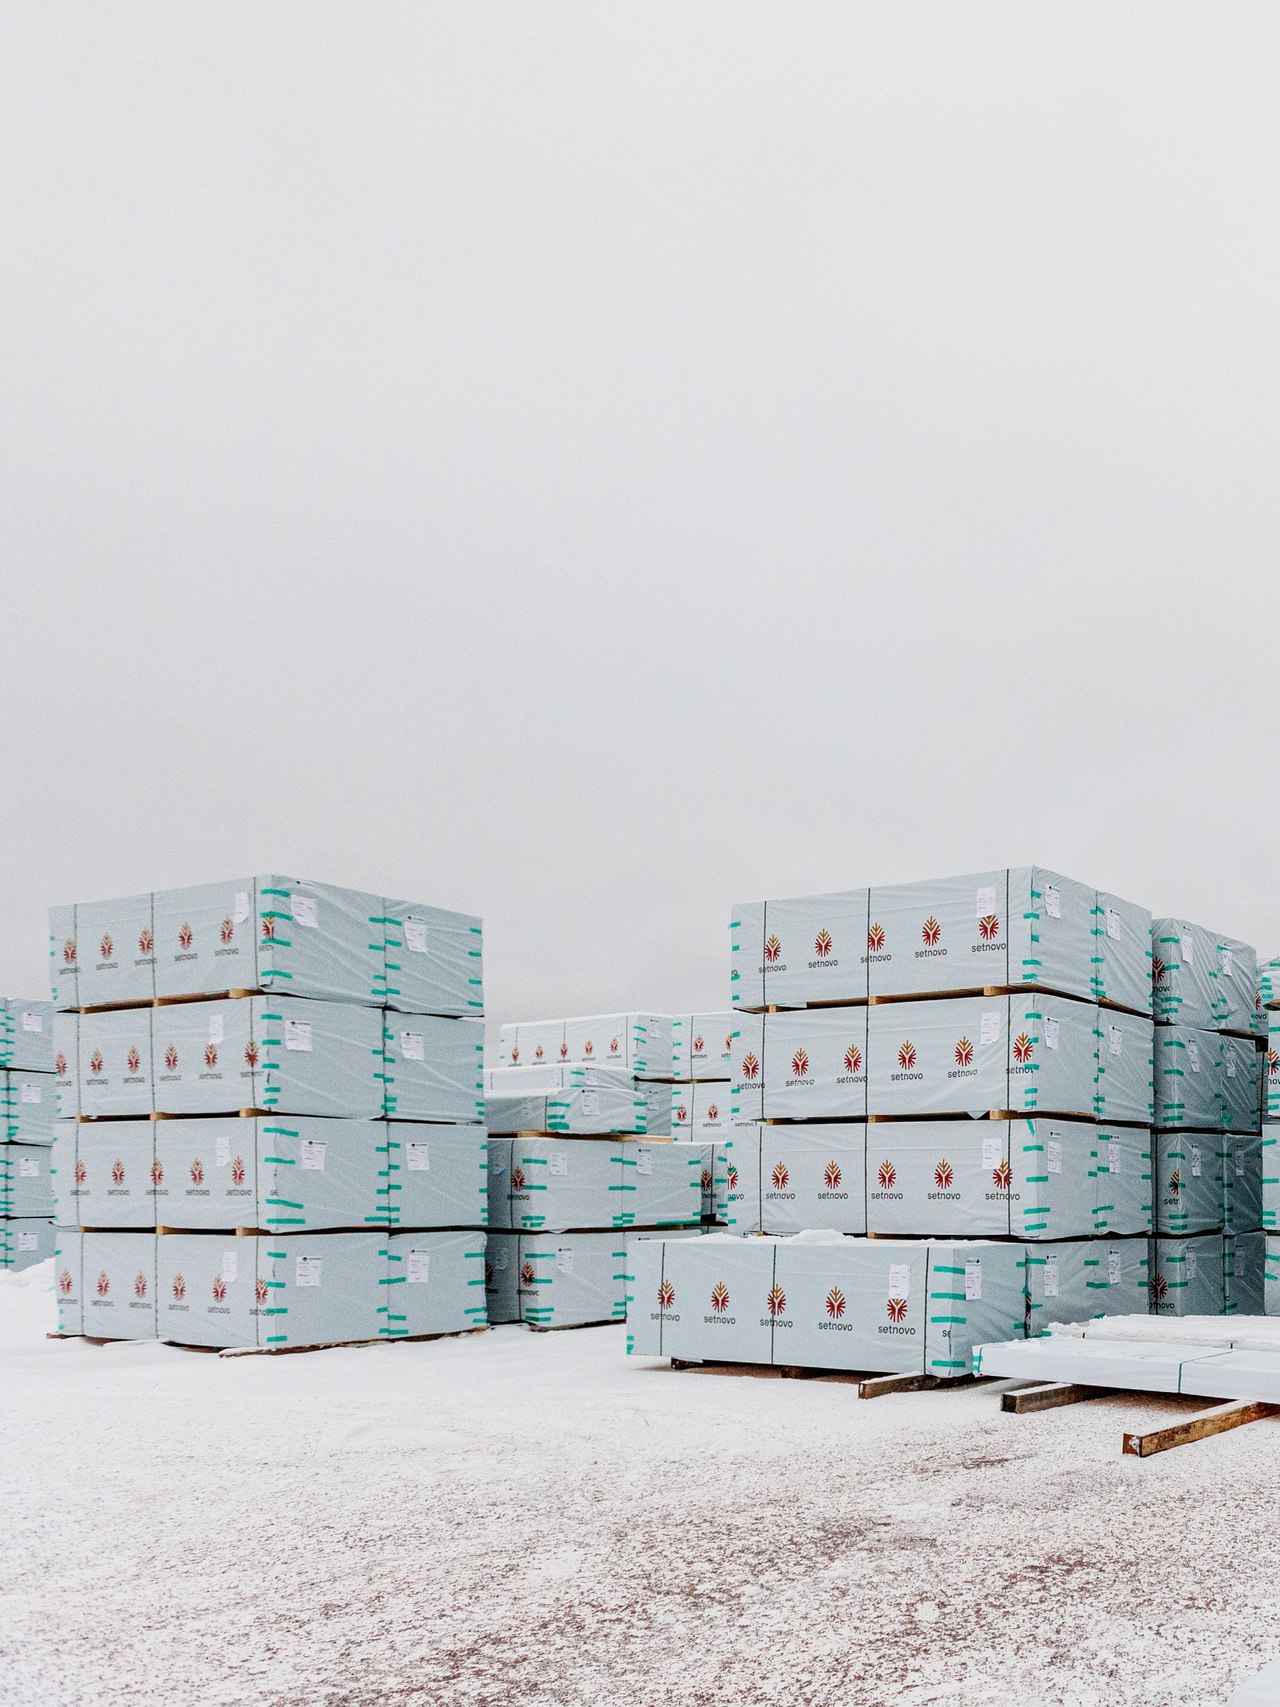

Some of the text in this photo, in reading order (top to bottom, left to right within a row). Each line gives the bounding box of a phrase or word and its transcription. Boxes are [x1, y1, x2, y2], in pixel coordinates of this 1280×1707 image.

[914, 946, 948, 958] setnovo
[971, 941, 1007, 953] setnovo
[808, 957, 839, 969] setnovo
[860, 952, 892, 964] setnovo
[836, 1074, 868, 1084] setnovo
[890, 1071, 924, 1081] setnovo
[947, 1068, 978, 1079] setnovo
[785, 1077, 815, 1087] setnovo
[765, 1191, 796, 1200] setnovo
[817, 1191, 849, 1200] setnovo
[871, 1191, 904, 1200] setnovo
[927, 1190, 961, 1200] setnovo
[985, 1190, 1021, 1201] setnovo
[703, 1314, 736, 1325] setnovo
[818, 1320, 853, 1332] setnovo
[878, 1323, 916, 1335] setnovo
